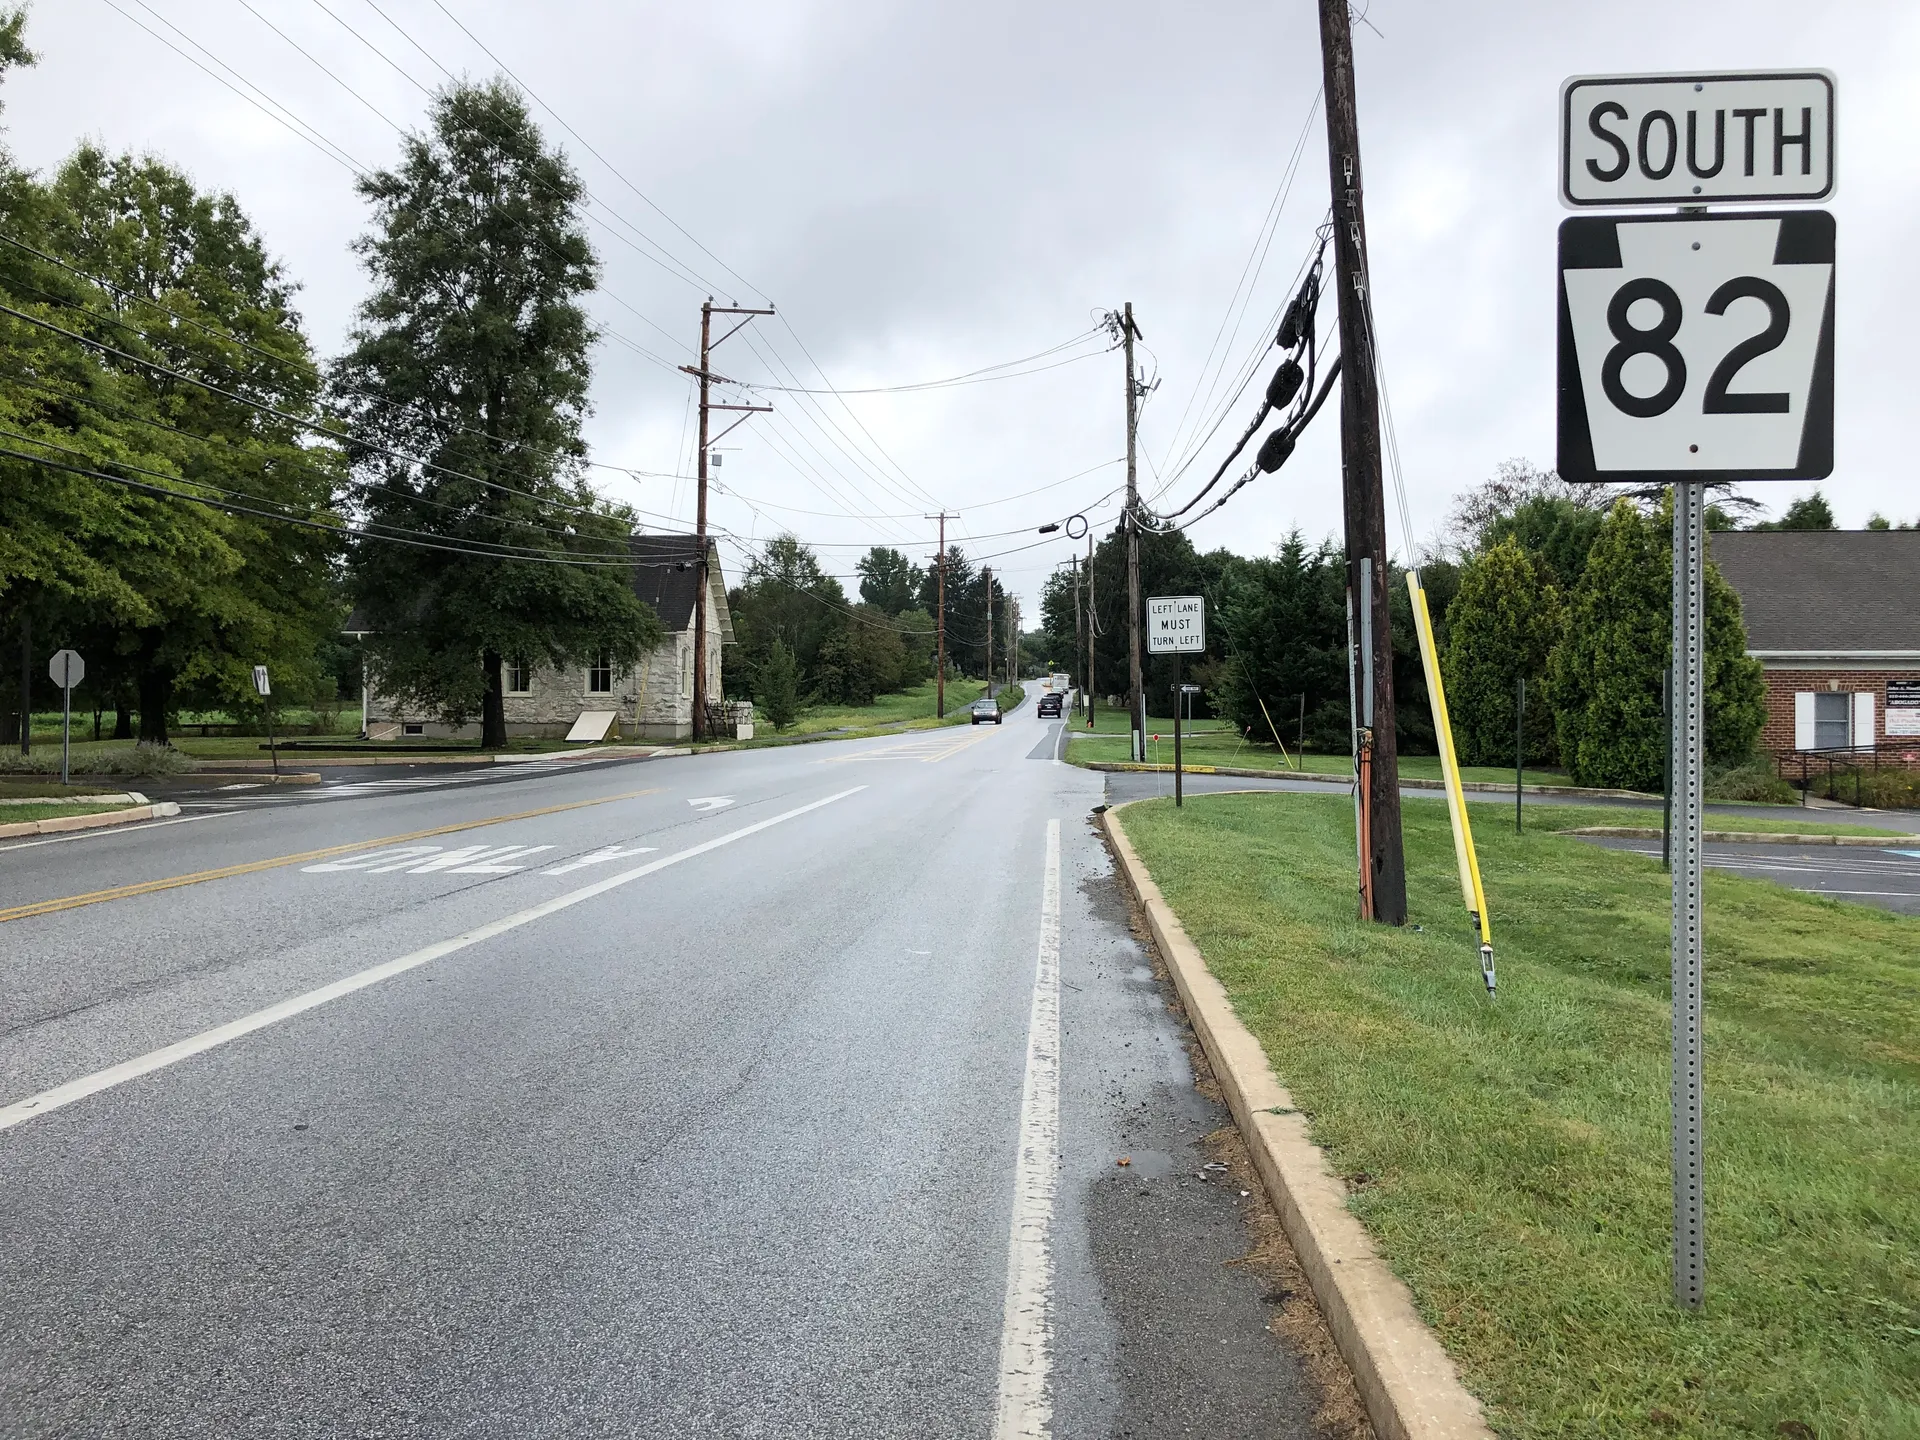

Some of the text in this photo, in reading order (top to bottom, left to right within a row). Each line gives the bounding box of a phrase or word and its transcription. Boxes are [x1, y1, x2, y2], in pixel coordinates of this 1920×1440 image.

[1585, 101, 1811, 182] SOUTH
[1601, 276, 1791, 418] 82
[1152, 603, 1199, 614] LEFT LANE
[1161, 619, 1191, 630] MUST
[1152, 635, 1200, 646] TURN LEFT
[300, 845, 660, 876] ONLY
